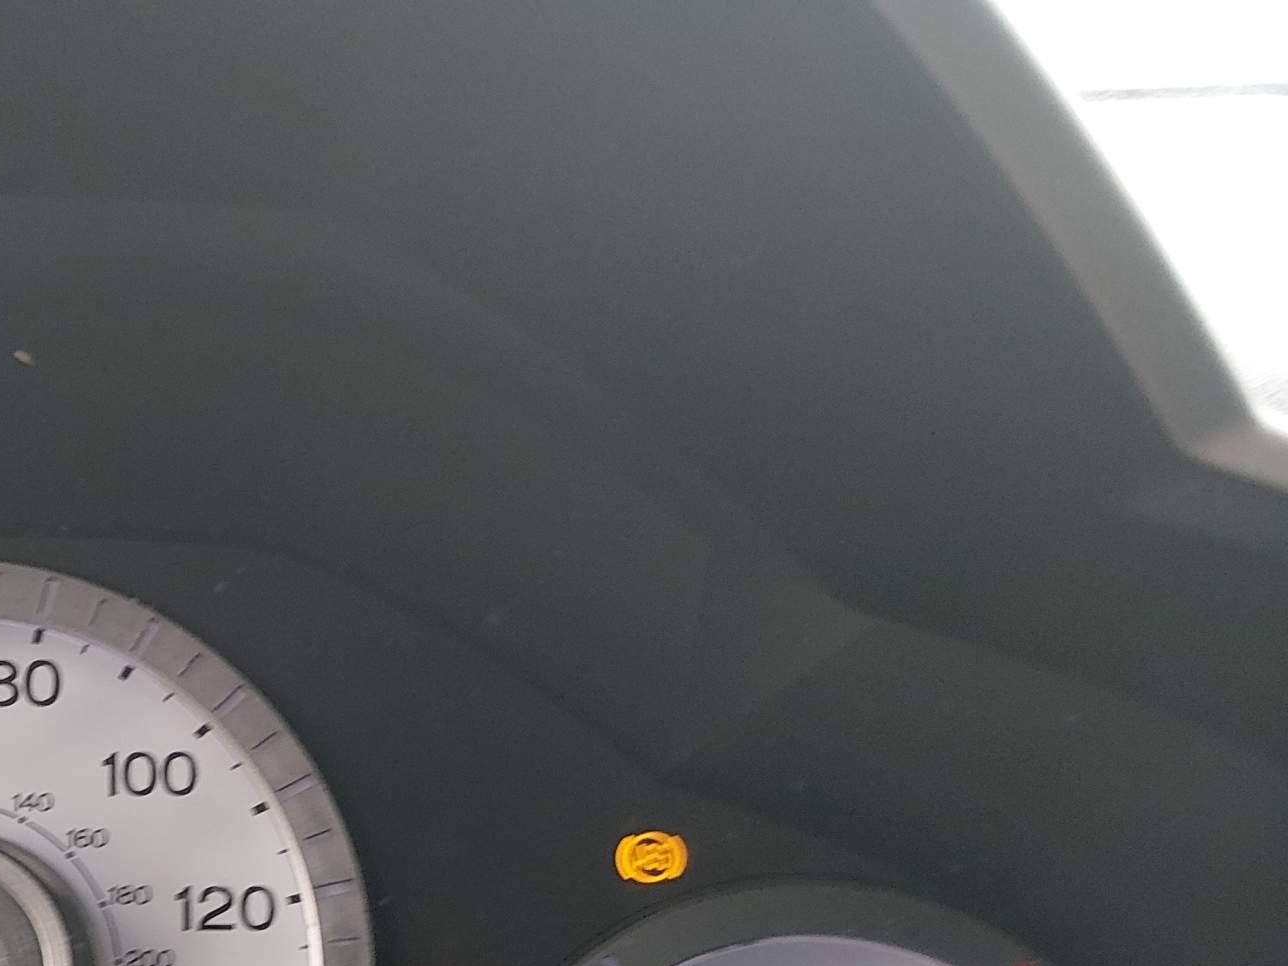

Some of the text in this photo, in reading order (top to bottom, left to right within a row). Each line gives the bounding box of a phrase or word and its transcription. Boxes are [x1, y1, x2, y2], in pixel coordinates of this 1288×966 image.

[103, 751, 198, 797] 100
[11, 792, 55, 813] 140
[65, 828, 109, 850] 160
[108, 884, 153, 906] 180
[173, 885, 275, 932] 120
